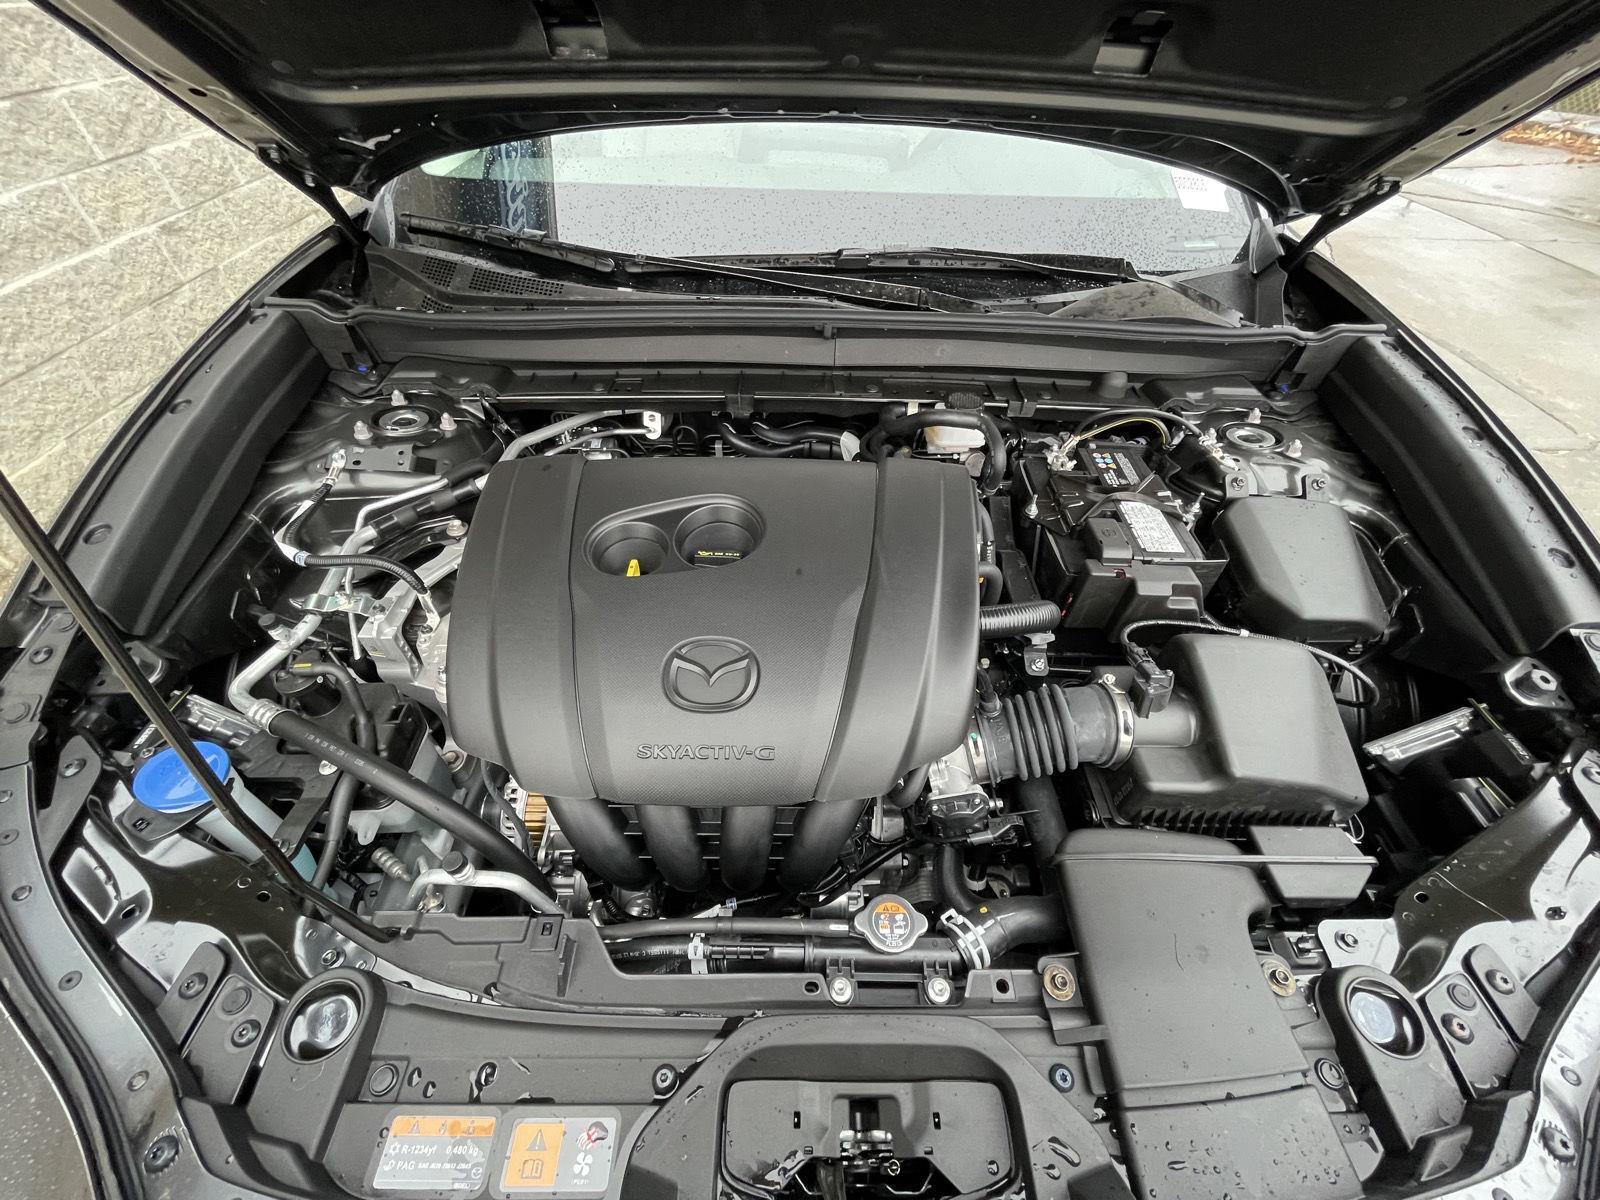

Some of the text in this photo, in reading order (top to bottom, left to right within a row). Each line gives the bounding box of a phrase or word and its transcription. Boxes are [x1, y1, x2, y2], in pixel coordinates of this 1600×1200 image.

[636, 743, 775, 761] SKYACTIV-G
[401, 1144, 437, 1156] R-1234yf
[396, 1160, 415, 1170] PAG
